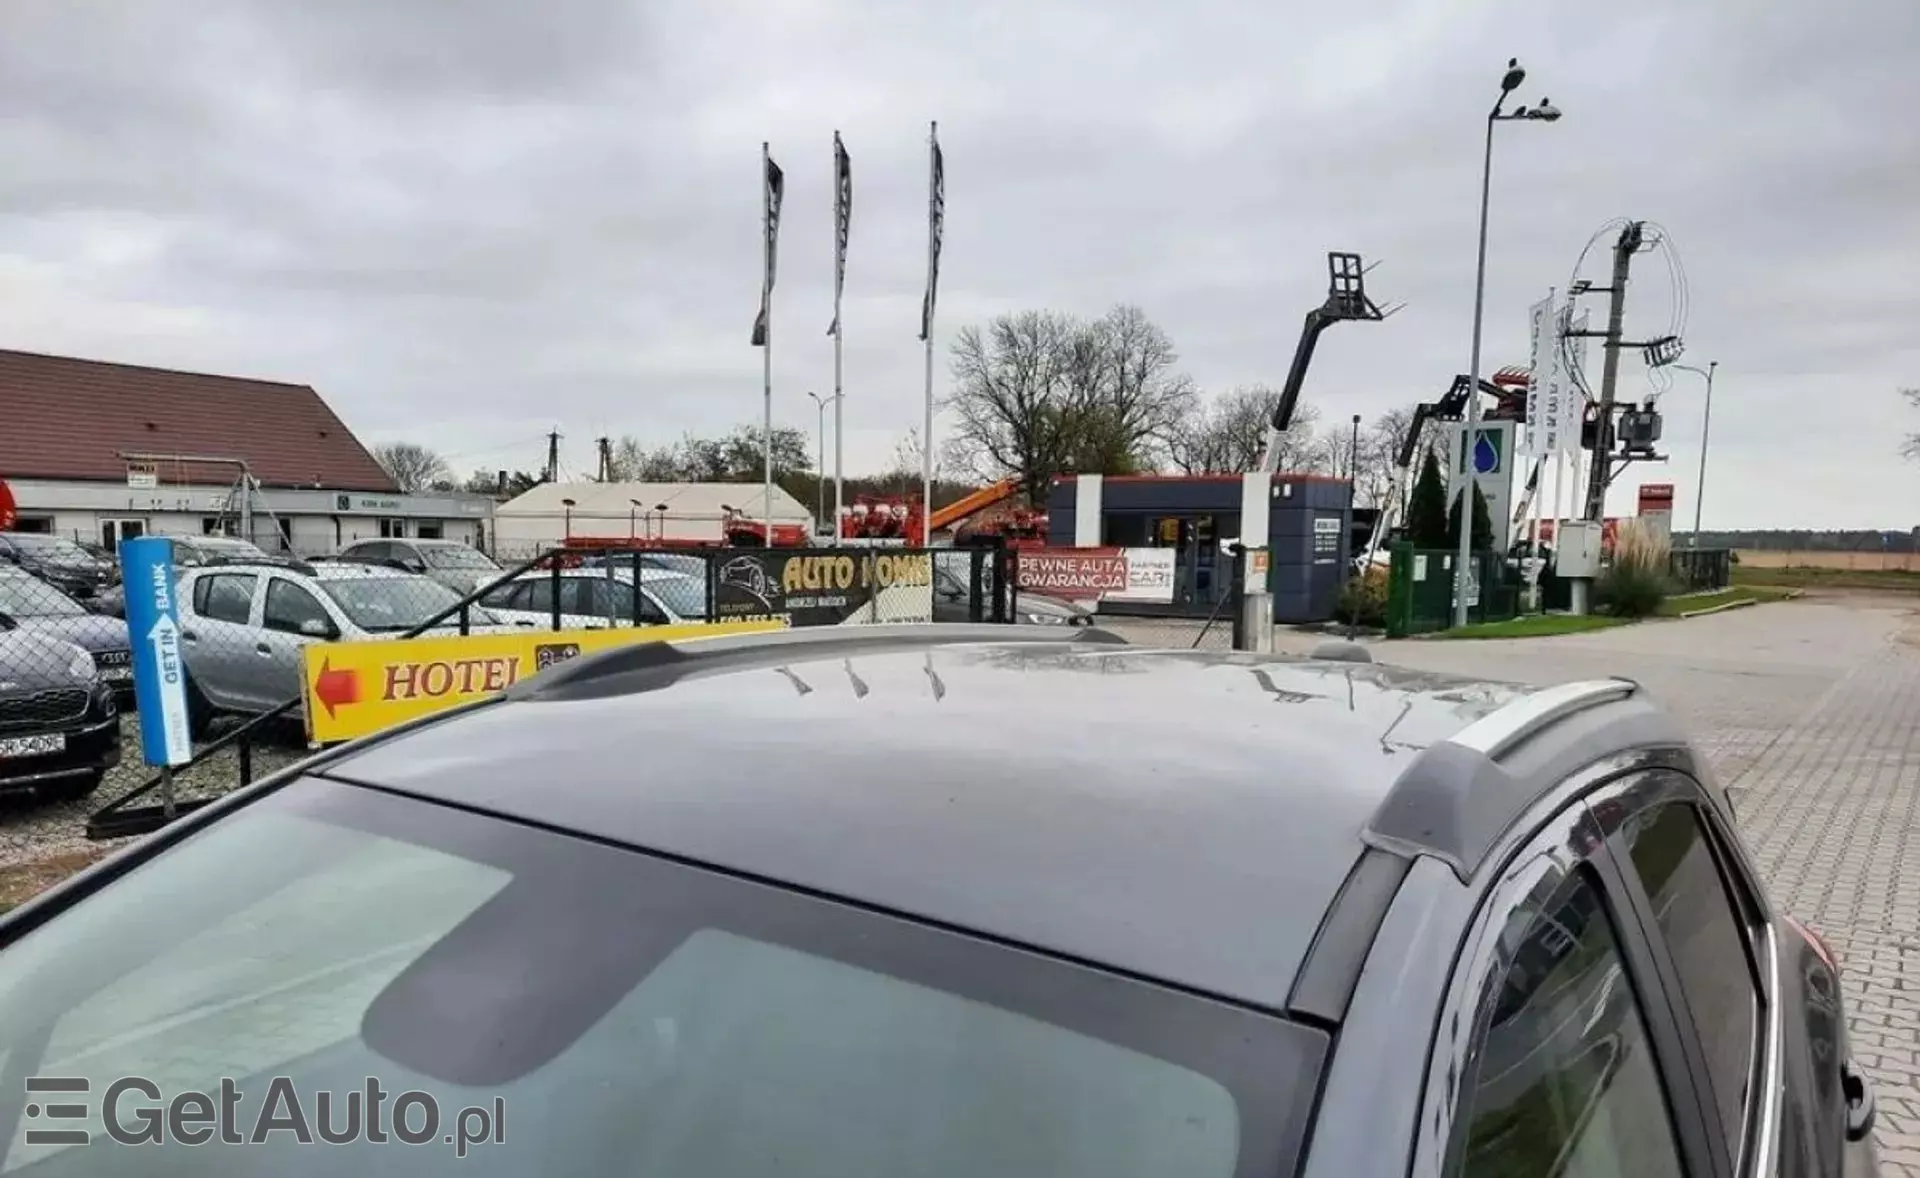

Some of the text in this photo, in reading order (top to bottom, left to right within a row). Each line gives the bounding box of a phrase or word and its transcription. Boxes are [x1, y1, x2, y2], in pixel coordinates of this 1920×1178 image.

[783, 556, 854, 593] AUTO
[1018, 558, 1125, 572] PEWNE AUTA
[1018, 573, 1125, 588] GWARANCJA
[152, 563, 171, 609] BANK
[160, 627, 178, 685] GET IN
